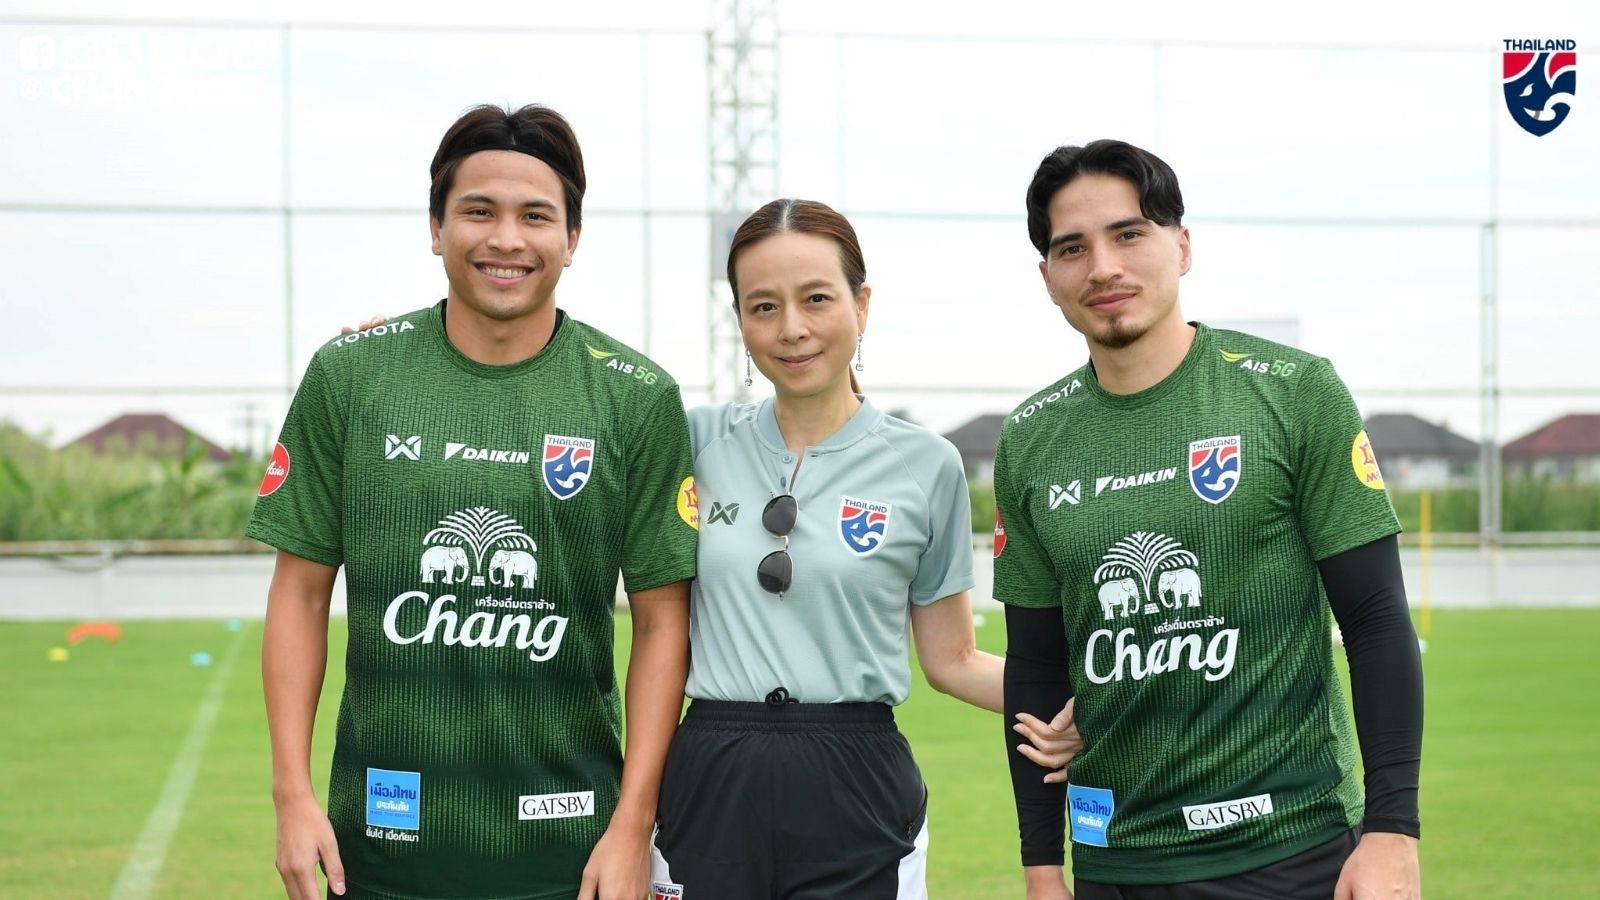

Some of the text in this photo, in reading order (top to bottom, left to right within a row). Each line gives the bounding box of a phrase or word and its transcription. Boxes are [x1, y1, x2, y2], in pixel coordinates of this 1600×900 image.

[332, 320, 415, 347] TOYOTA
[606, 358, 658, 385] AIS 5G
[1240, 359, 1296, 377] AIS 5G
[1012, 379, 1082, 424] TOYOTA
[548, 437, 592, 449] THAILAND
[1192, 438, 1238, 451] THAILAND
[462, 447, 530, 464] DAIKIN
[1111, 467, 1178, 491] DAIKIN
[844, 498, 888, 514] THAILAND
[475, 594, 555, 610] เครื่องดื่มตราช้าง
[383, 591, 569, 662] Chang
[1085, 627, 1240, 684] Chang
[522, 795, 590, 816] GATSBY
